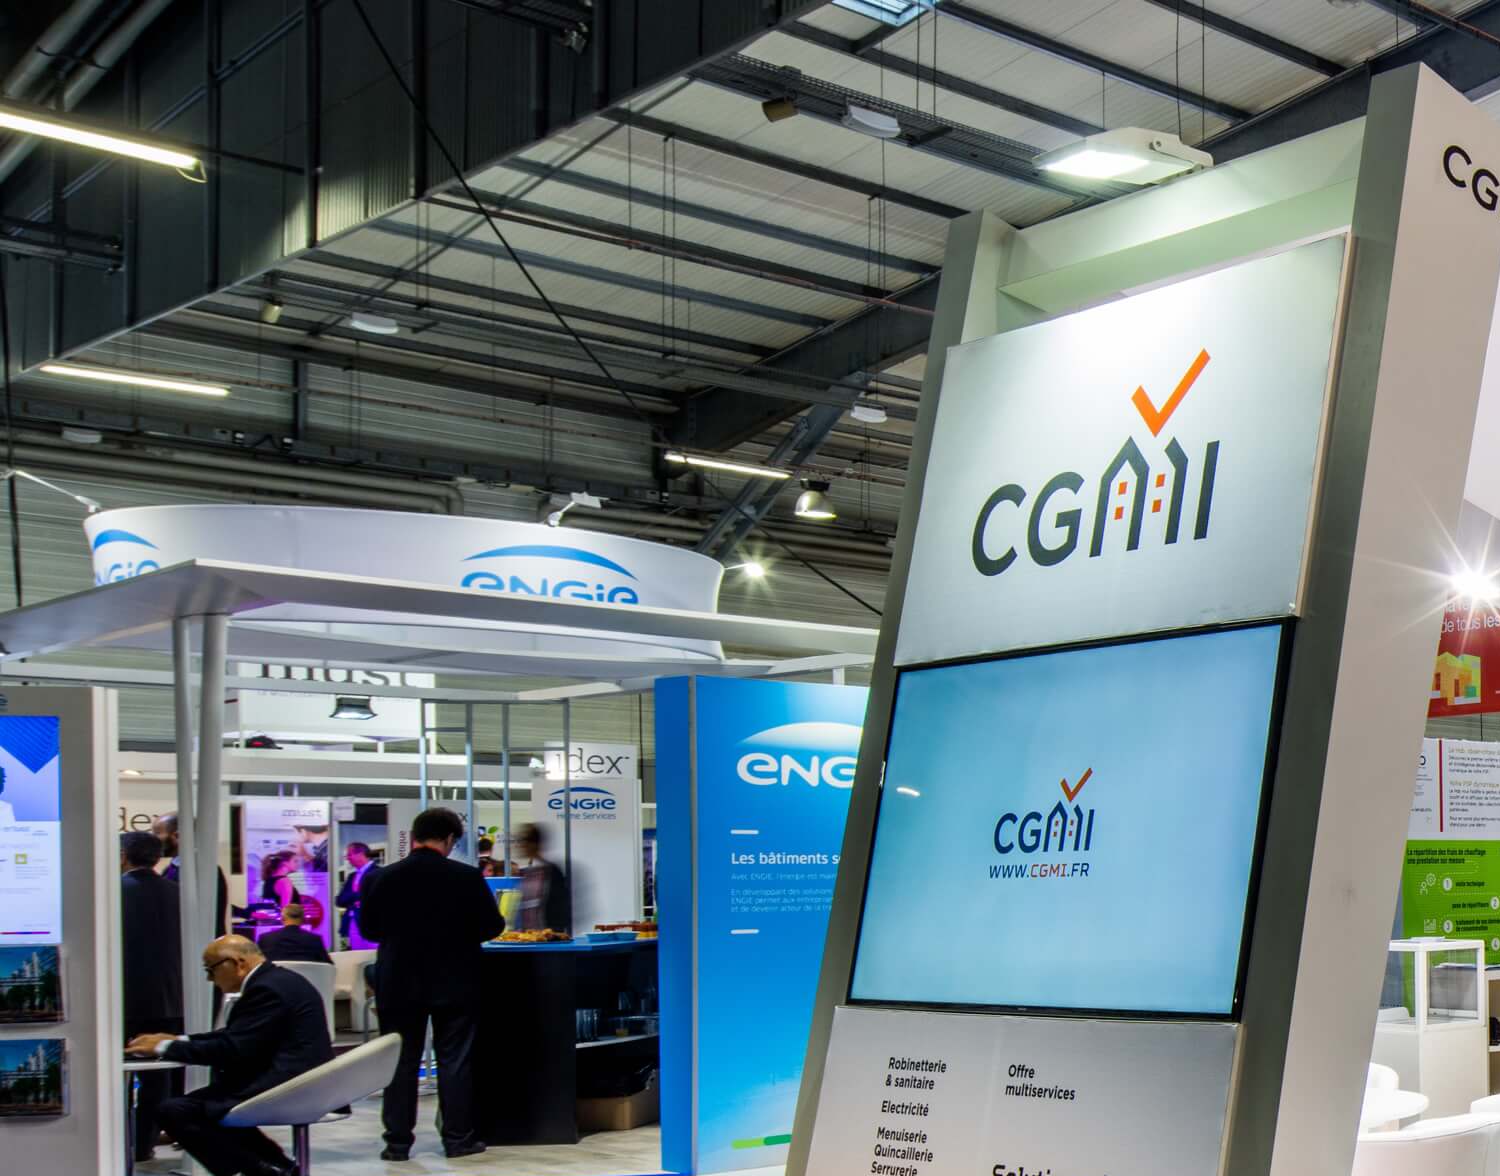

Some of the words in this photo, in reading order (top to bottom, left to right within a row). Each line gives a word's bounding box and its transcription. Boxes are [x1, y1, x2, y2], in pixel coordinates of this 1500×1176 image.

[972, 435, 1220, 577] CGMI
[1457, 616, 1480, 631] tous
[993, 800, 1095, 855] CGMI
[731, 852, 755, 865] Les
[760, 851, 829, 865] bâtiments
[989, 863, 1090, 879] WWW.CGMI.FR
[888, 1056, 947, 1073] Robinetterie
[1008, 1064, 1035, 1079] Offre
[885, 1074, 892, 1087] &
[894, 1075, 935, 1091] sanitaire
[1005, 1083, 1075, 1101] multiservices
[881, 1100, 929, 1117] Electricité
[876, 1126, 928, 1144] Menuiserie
[874, 1144, 934, 1163] Quincaillerie
